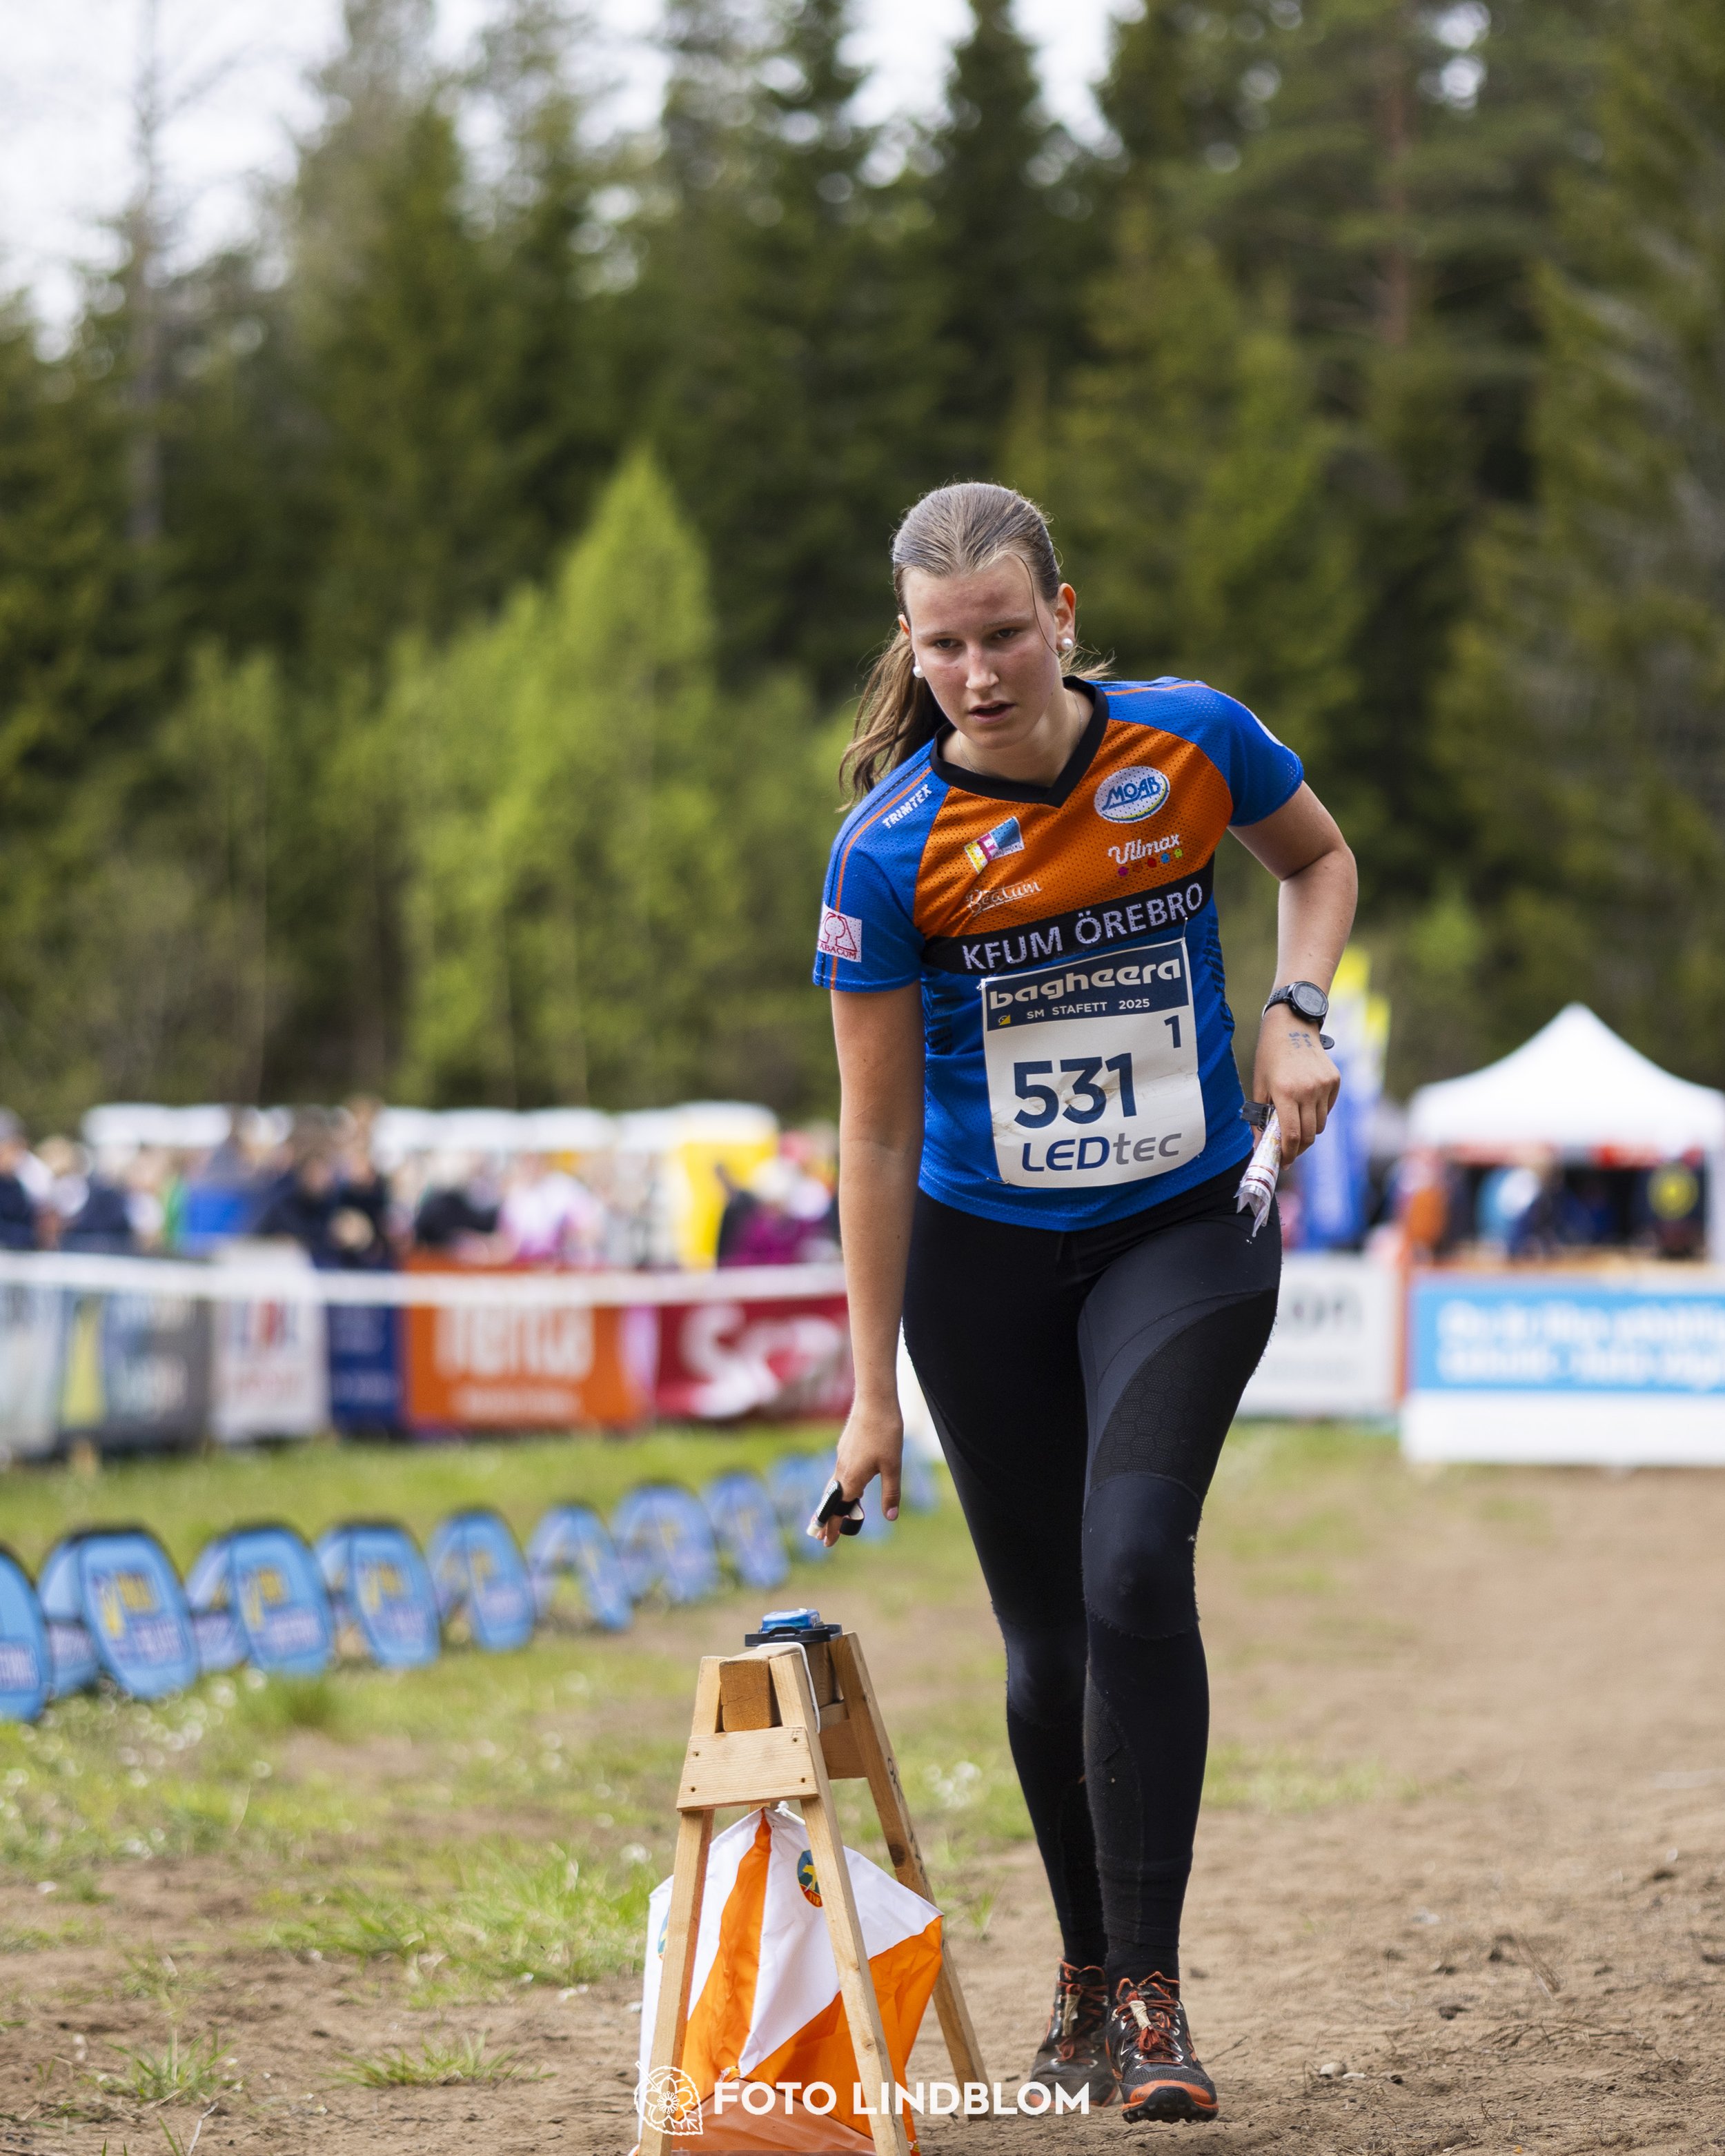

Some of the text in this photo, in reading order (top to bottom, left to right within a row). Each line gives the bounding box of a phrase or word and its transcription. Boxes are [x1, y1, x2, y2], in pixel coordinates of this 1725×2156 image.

[883, 784, 932, 829] TRIMTEX
[1102, 776, 1161, 811] MOAB
[1107, 833, 1181, 864] Ullmax
[963, 883, 1203, 969] KFUM ÖREBRO
[820, 943, 857, 960] ABACUM
[989, 958, 1181, 1009] bagheera
[1027, 998, 1150, 1019] SM STAFETT 2025
[1163, 1015, 1181, 1049] 1
[1014, 1052, 1137, 1129] 531
